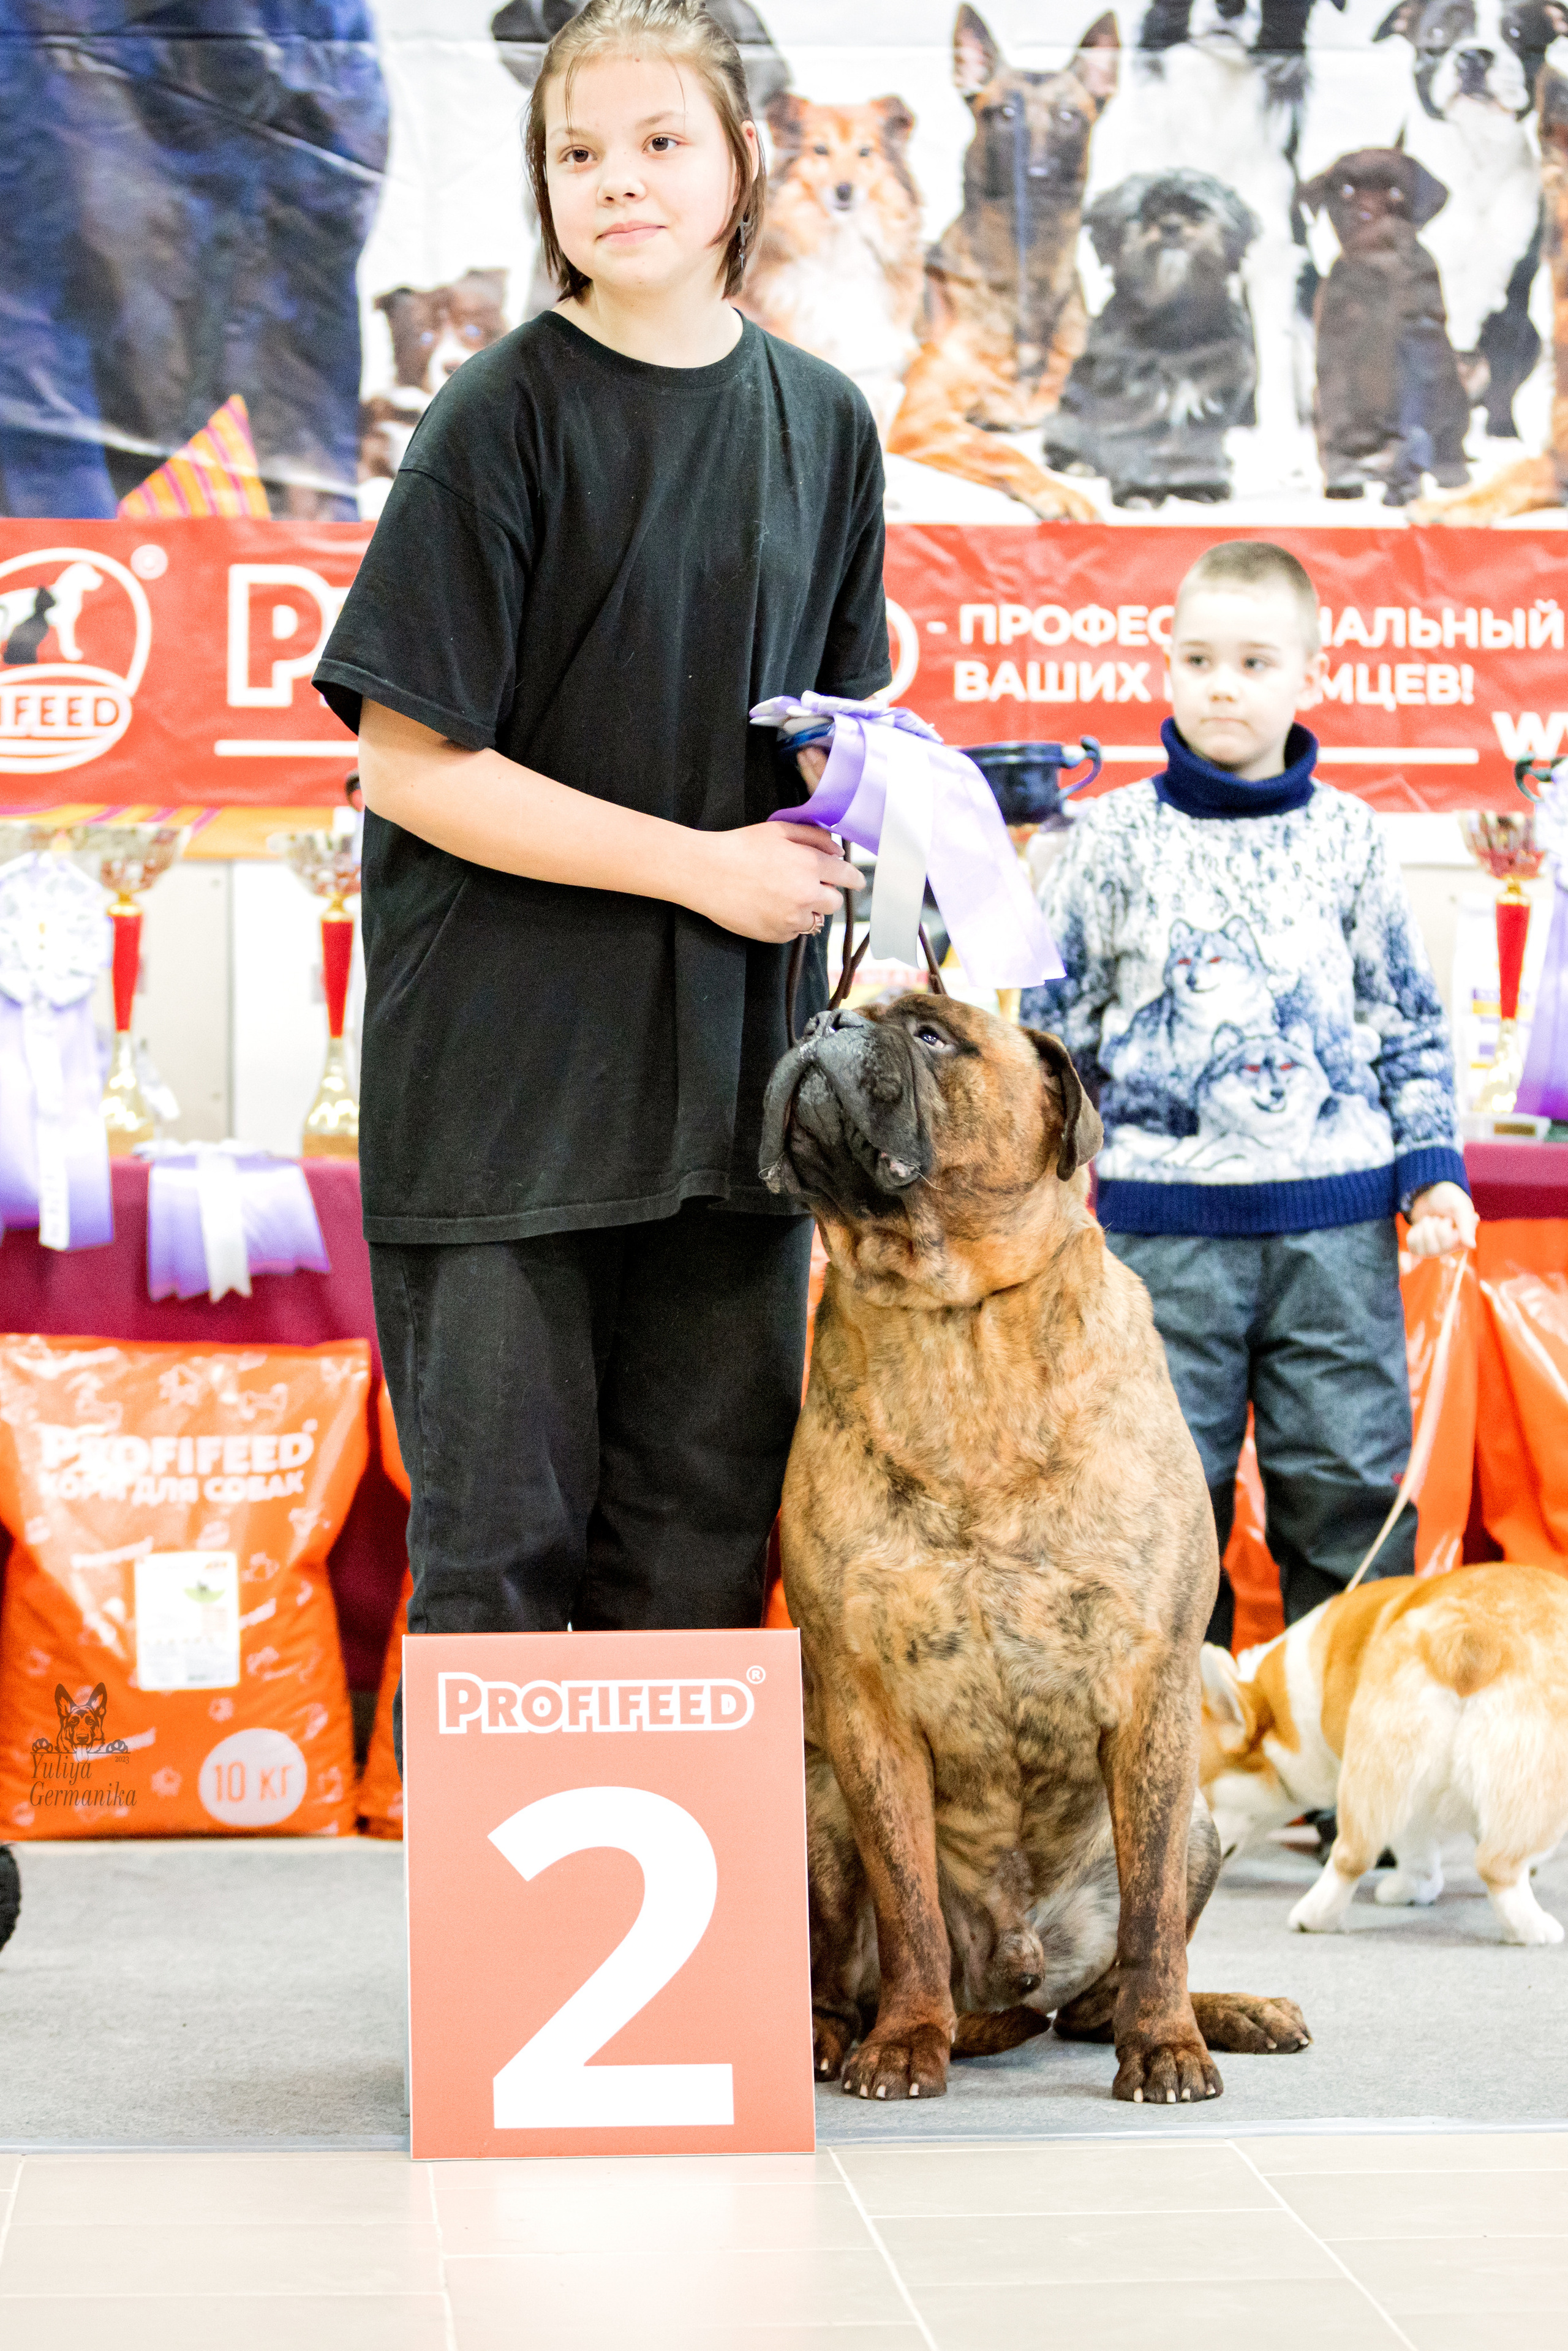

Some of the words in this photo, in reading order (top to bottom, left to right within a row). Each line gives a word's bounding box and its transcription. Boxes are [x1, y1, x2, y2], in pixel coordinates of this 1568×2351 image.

[954, 660, 1152, 703] ВАШИХ
[131, 1476, 198, 1507] ДЛЯ
[203, 1470, 304, 1503] СОБАК
[214, 1761, 246, 1803] 10
[487, 1786, 734, 2129] 2
